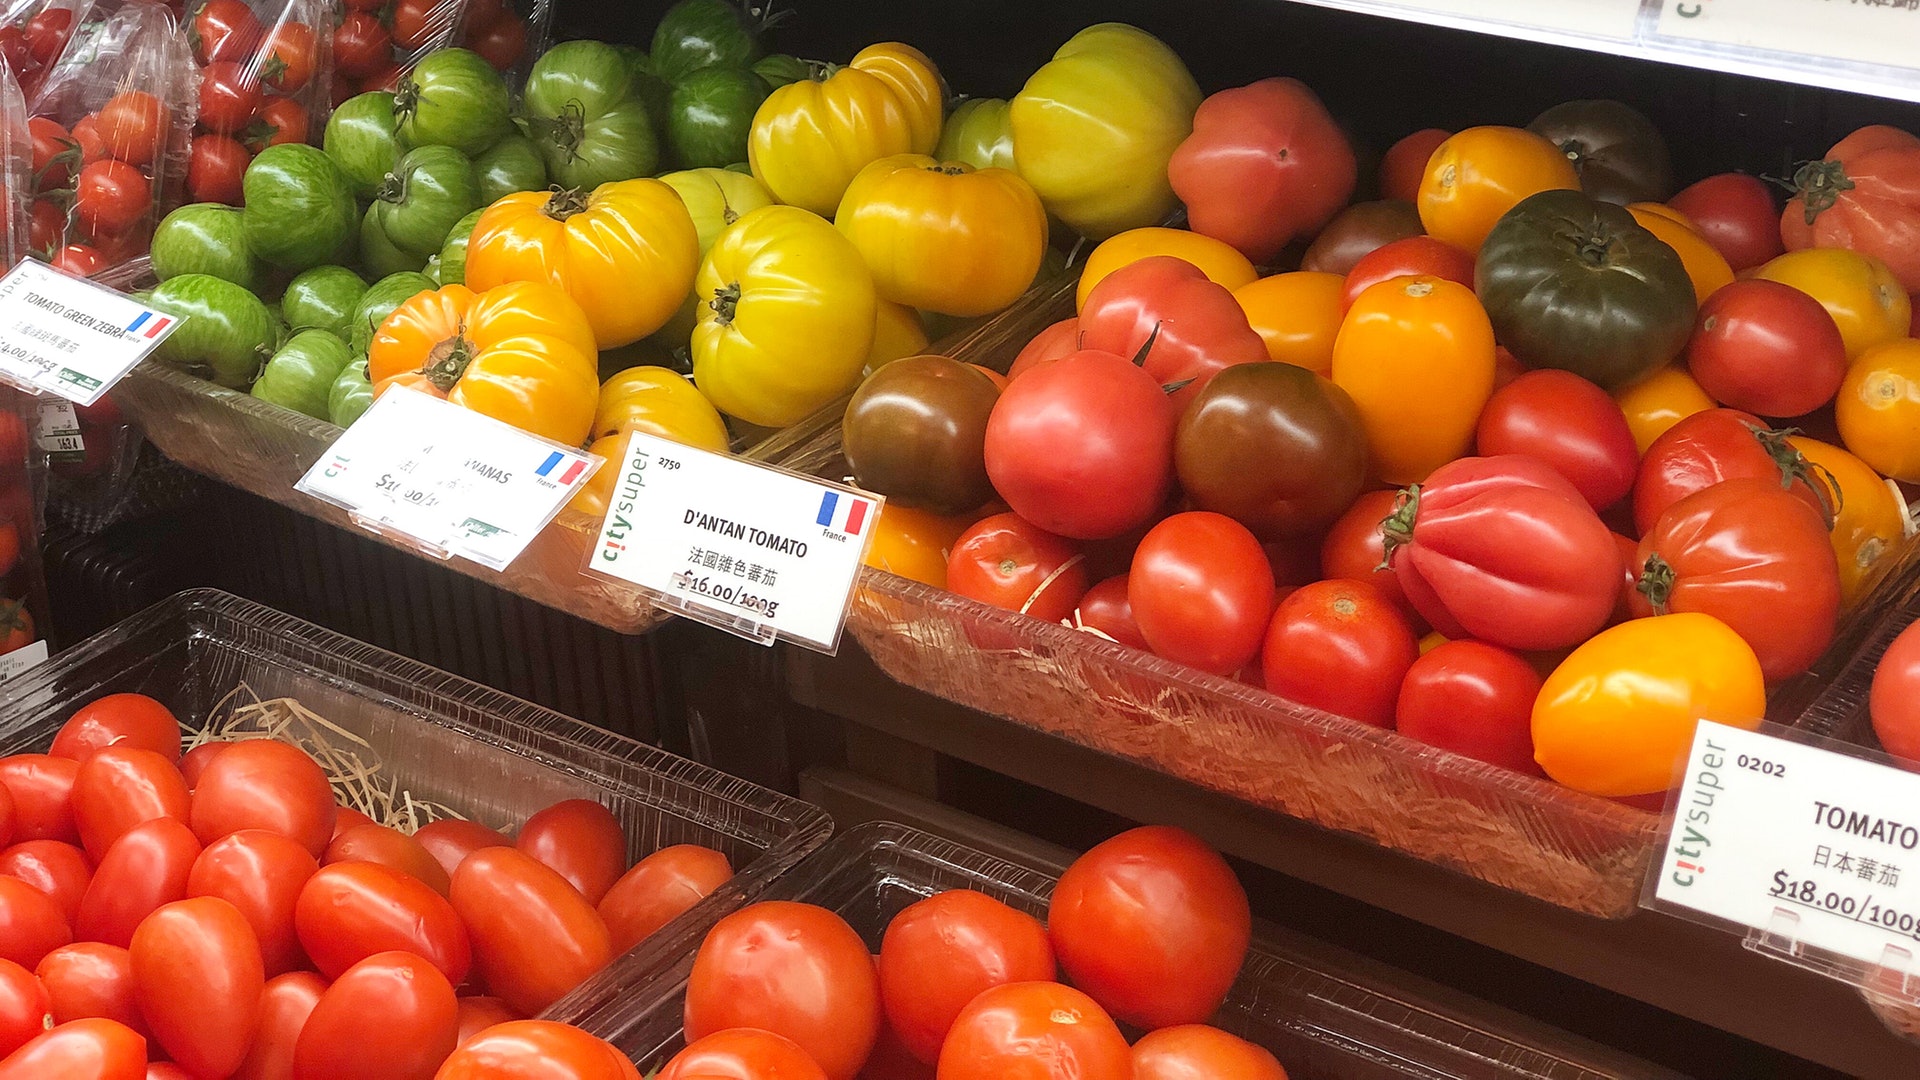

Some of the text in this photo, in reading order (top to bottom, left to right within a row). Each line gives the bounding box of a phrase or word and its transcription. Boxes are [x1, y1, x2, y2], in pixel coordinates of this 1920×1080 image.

[23, 292, 127, 340] TOMATO GREEN ZEBRA
[537, 477, 557, 490] France
[658, 456, 681, 471] 2750
[683, 508, 808, 559] D'ANTAN TOMATO
[822, 528, 847, 544] France
[677, 569, 780, 619] $16.00/100g
[1737, 754, 1786, 778] 0202
[1814, 801, 1919, 850] TOMATO
[1813, 845, 1902, 889] 日本蕃茄
